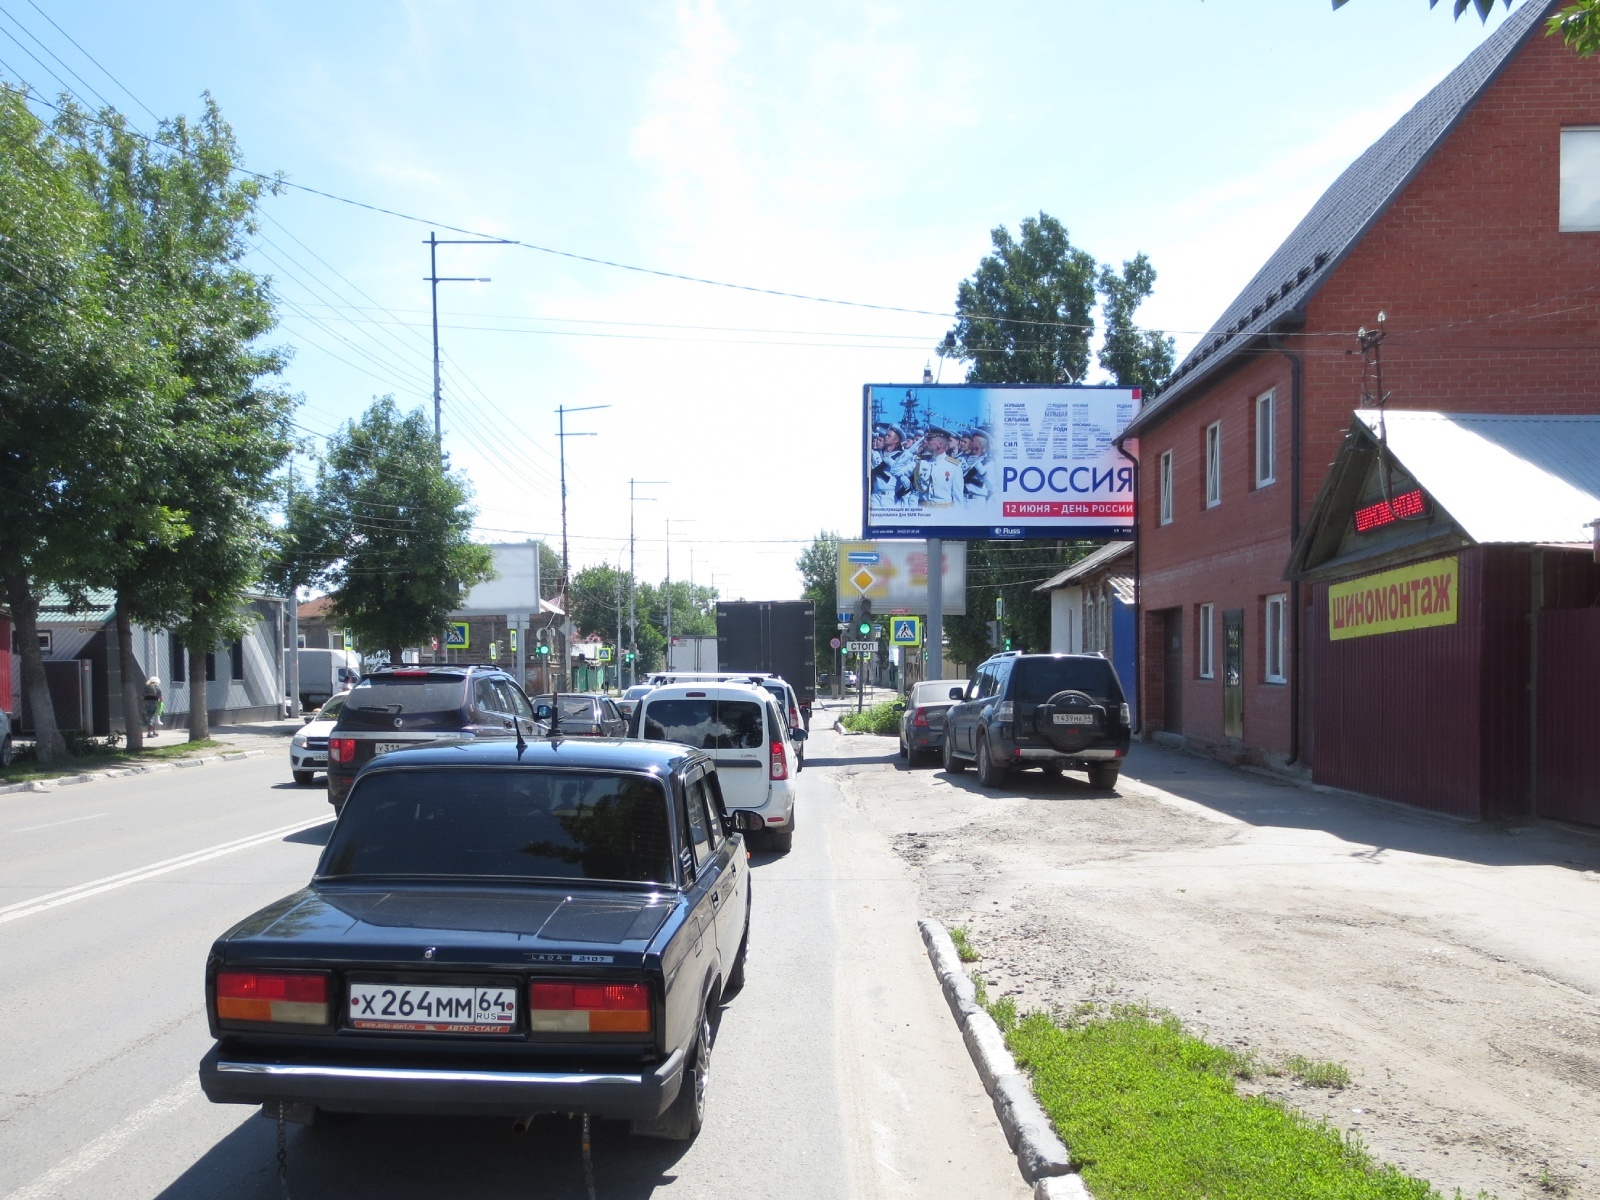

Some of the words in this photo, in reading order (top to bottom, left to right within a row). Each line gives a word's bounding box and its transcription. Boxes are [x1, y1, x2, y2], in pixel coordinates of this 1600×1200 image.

[1002, 466, 1133, 493] РОССИЯ
[1005, 504, 1017, 513] 12
[1020, 504, 1050, 513] ИЮНЯ
[1061, 504, 1089, 514] ДЕНЬ
[1092, 504, 1133, 513] РОССИИ
[850, 642, 874, 650] СТОП
[361, 990, 472, 1018] Х264ММ
[478, 991, 506, 1012] 64
[362, 1022, 416, 1030] www.avto-start.ru
